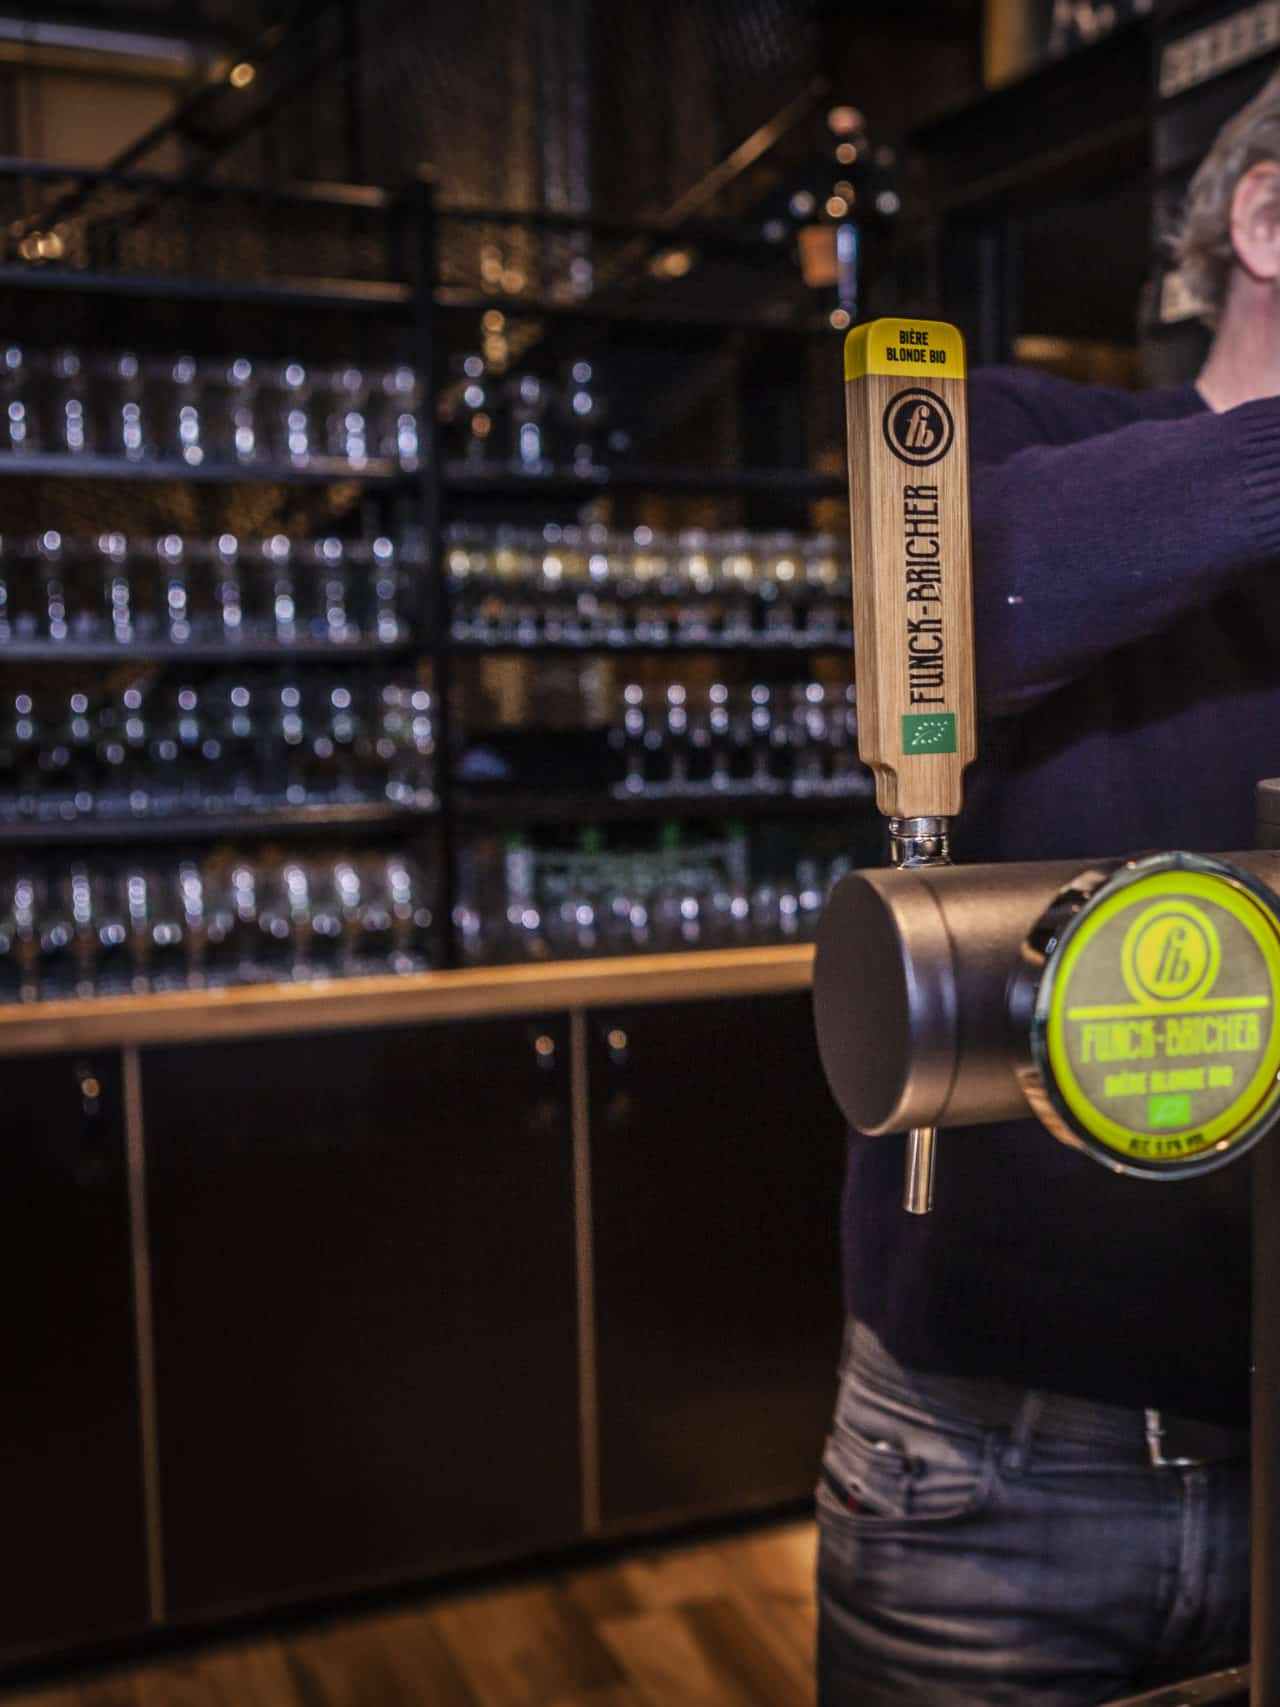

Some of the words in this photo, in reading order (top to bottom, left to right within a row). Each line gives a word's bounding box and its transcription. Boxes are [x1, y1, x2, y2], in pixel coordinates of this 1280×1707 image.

[899, 328, 929, 345] BIÈRE
[886, 347, 927, 363] BLONDE
[929, 349, 946, 364] BIO
[903, 484, 945, 705] FUNCK-BRICHER
